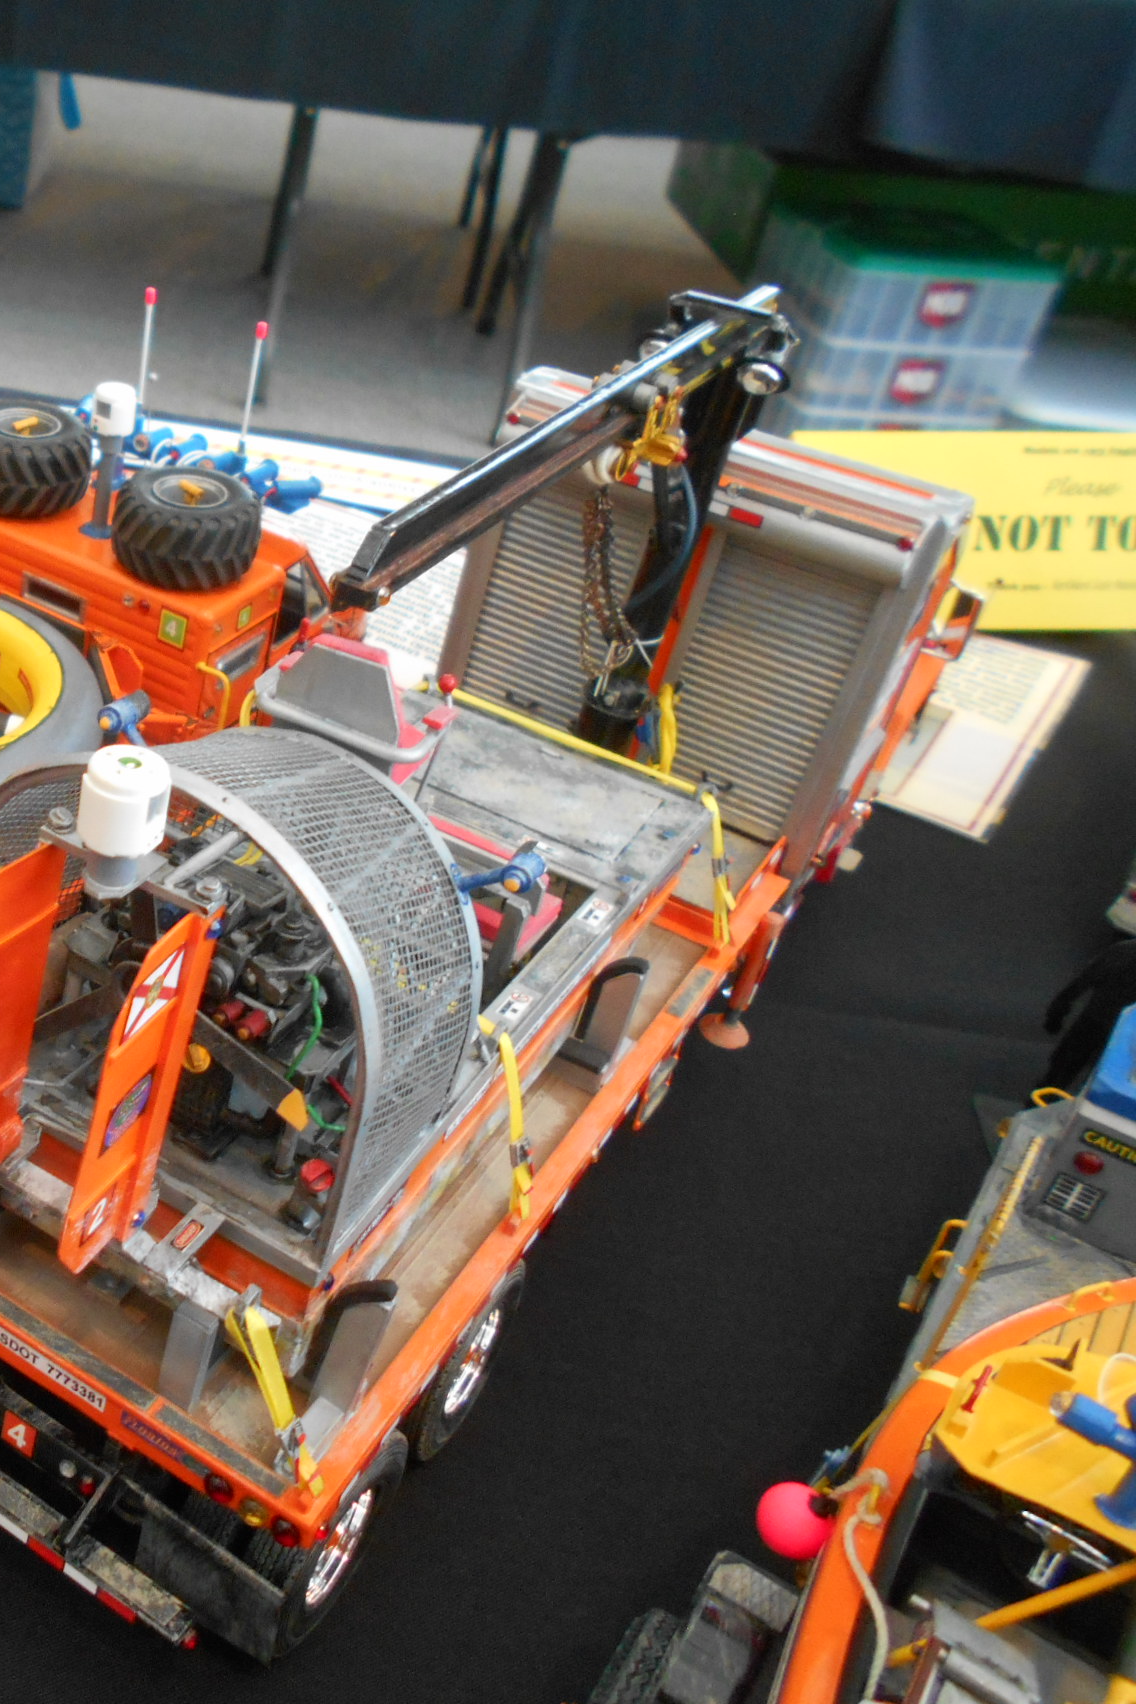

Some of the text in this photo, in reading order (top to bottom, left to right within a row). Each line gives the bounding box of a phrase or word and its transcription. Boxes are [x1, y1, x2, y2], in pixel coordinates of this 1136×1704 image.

[1044, 476, 1122, 497] Please
[974, 514, 1136, 552] NOT TO
[165, 621, 178, 638] 4
[1084, 1131, 1136, 1165] CAUTI
[87, 1197, 108, 1236] 2
[46, 1363, 106, 1409] 7773381
[7, 1423, 28, 1448] 4
